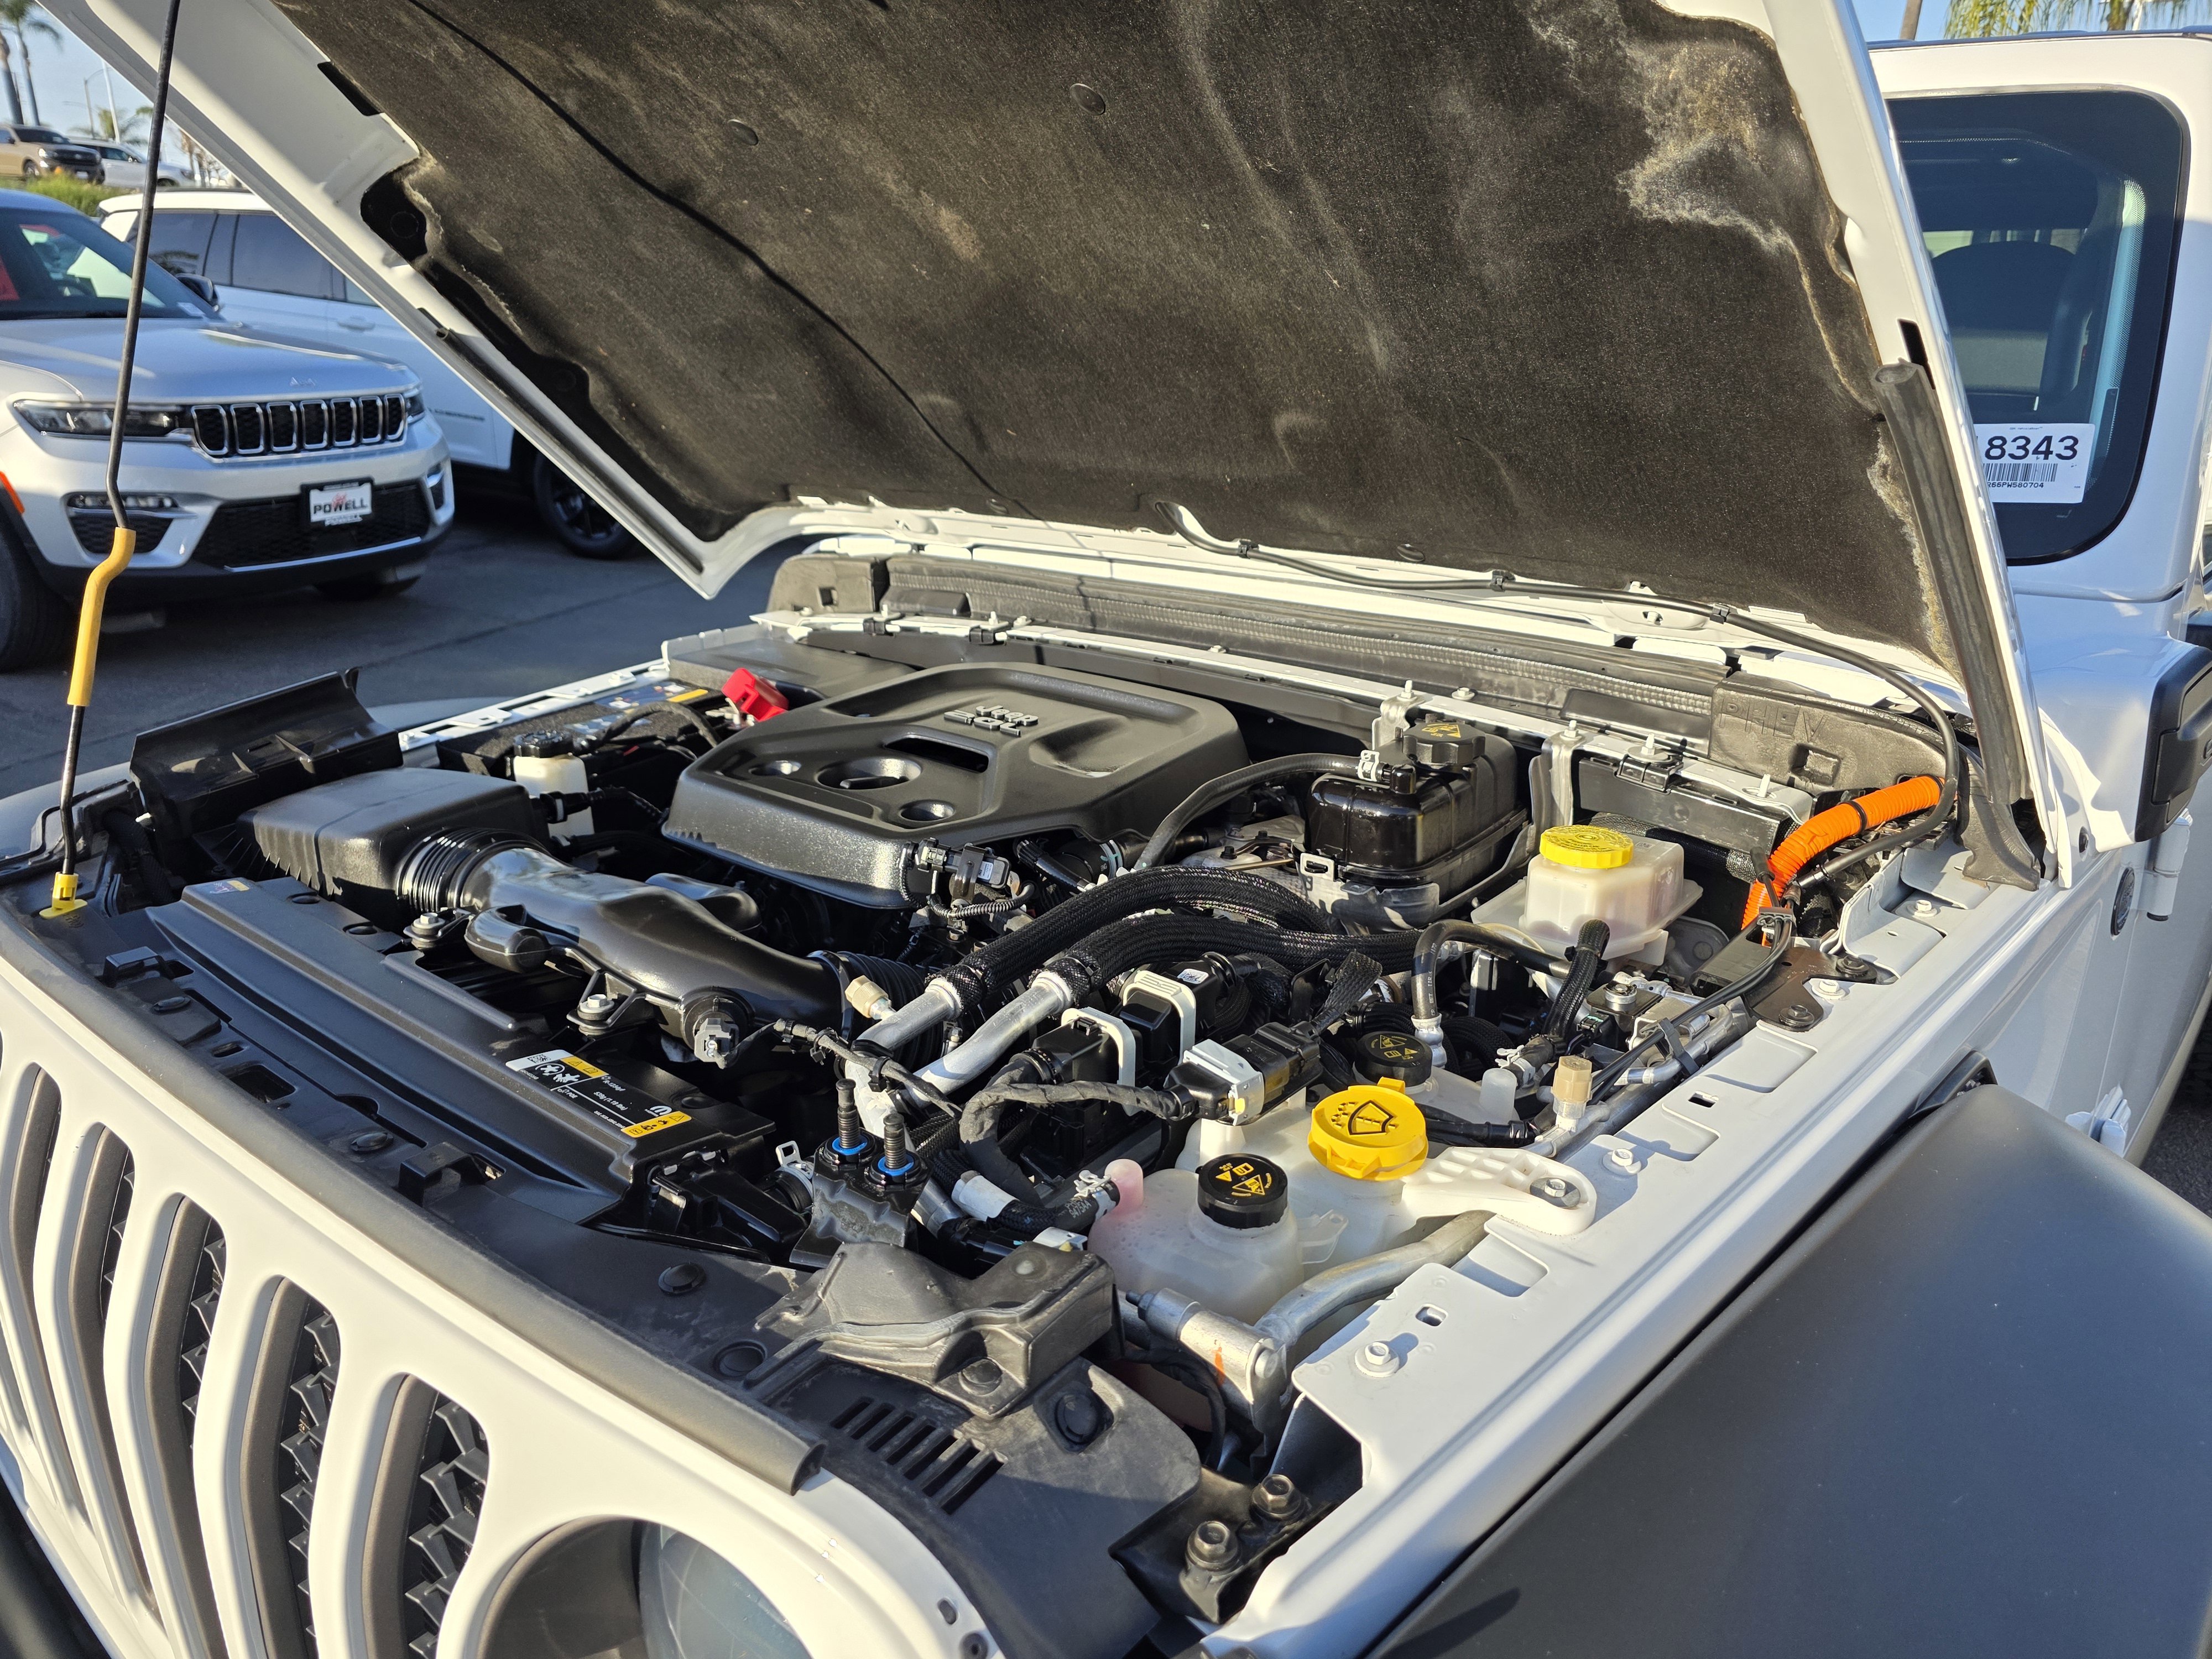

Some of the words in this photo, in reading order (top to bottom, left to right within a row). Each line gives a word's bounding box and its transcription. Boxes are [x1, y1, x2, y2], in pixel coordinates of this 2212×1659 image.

[1984, 435, 2079, 460] 8343
[313, 498, 368, 514] POWELL
[943, 709, 1021, 737] 2.0L
[975, 705, 1039, 727] Jeep
[1719, 698, 1829, 743] PHEV
